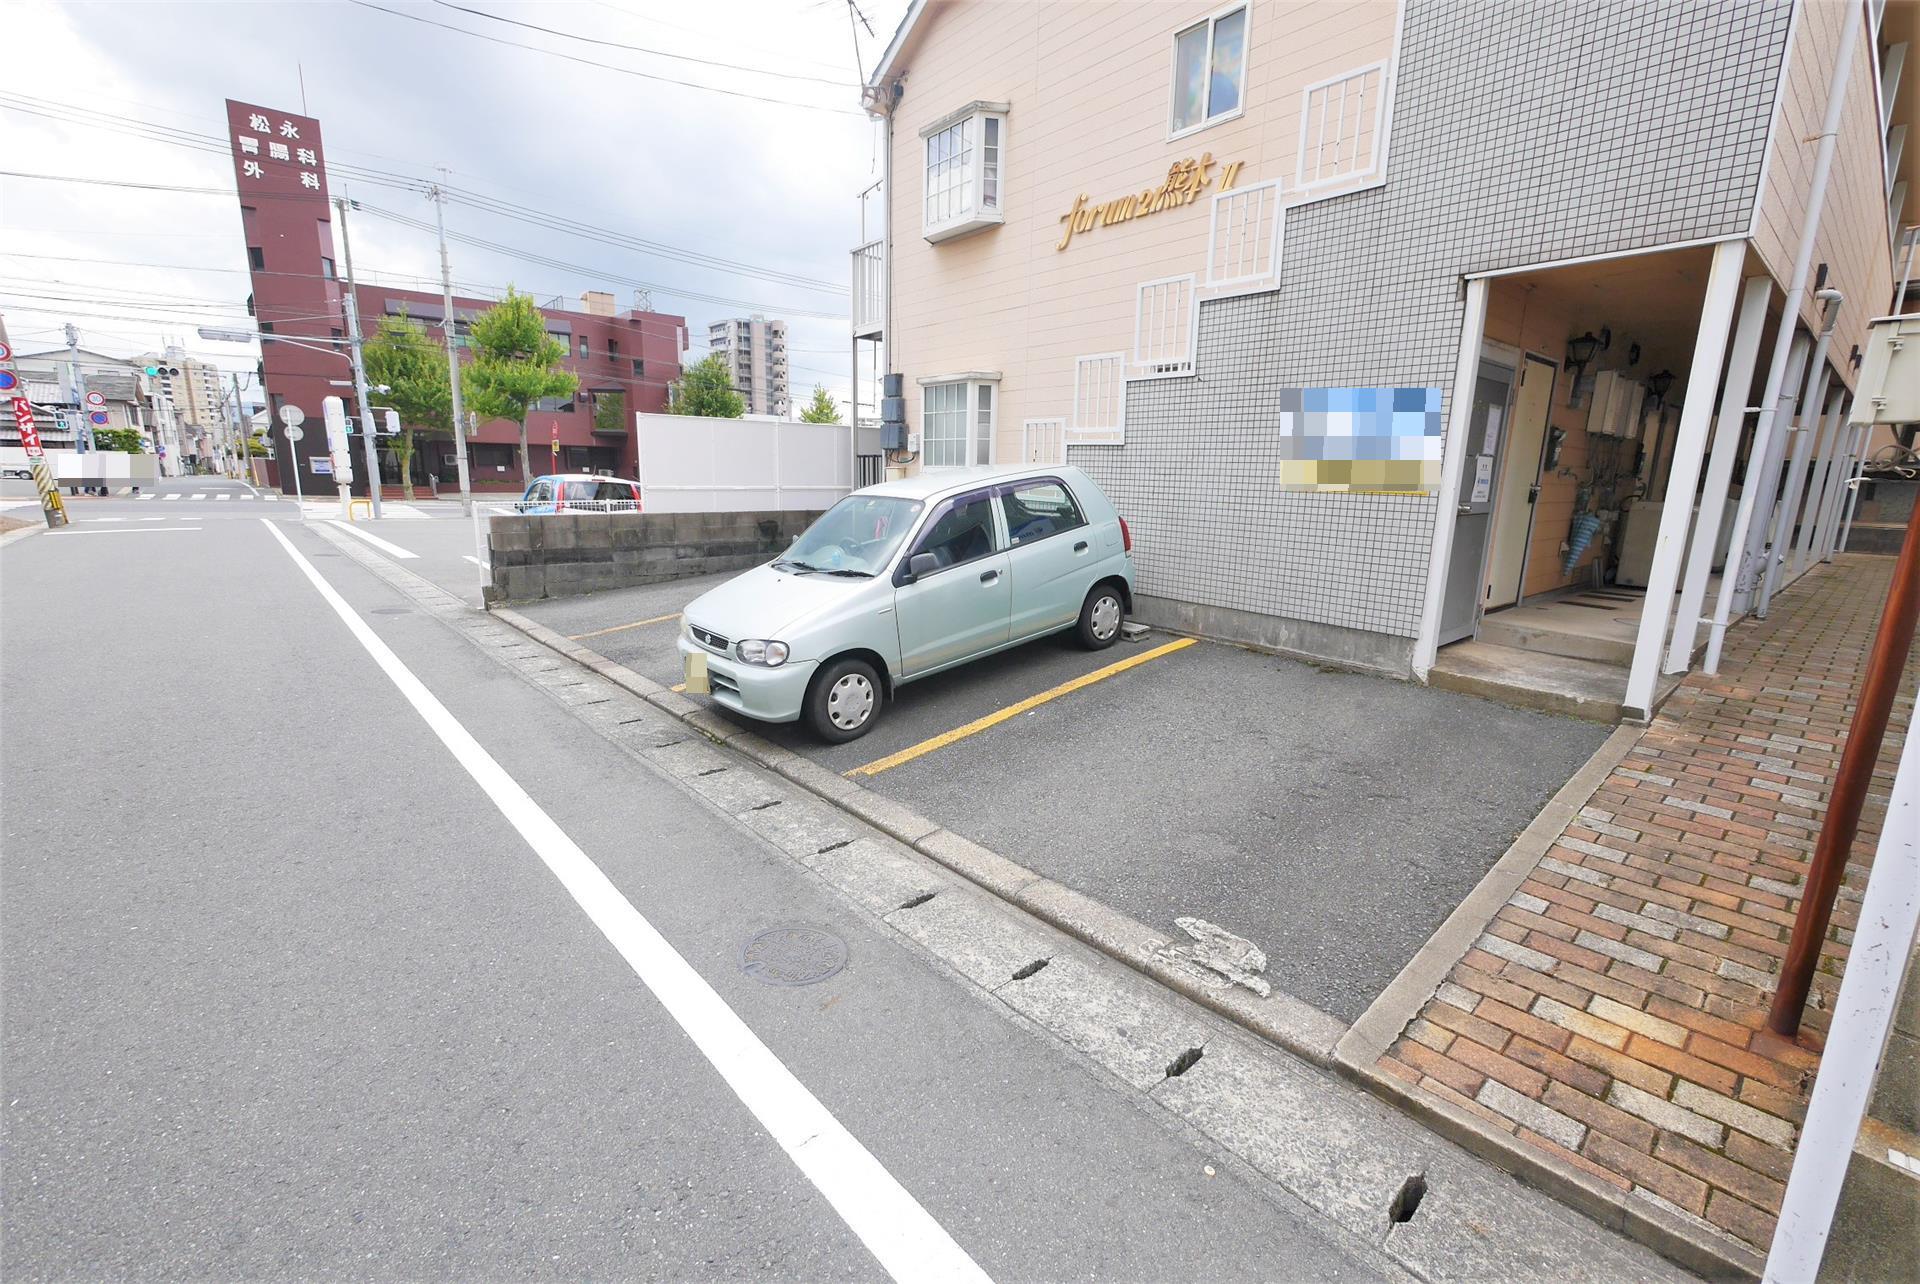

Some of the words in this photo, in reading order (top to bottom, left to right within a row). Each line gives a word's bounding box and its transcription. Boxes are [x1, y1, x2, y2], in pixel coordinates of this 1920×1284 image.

[248, 113, 301, 139] 松永
[238, 135, 318, 167] 胃腸科
[13, 400, 38, 446] バンザイ
